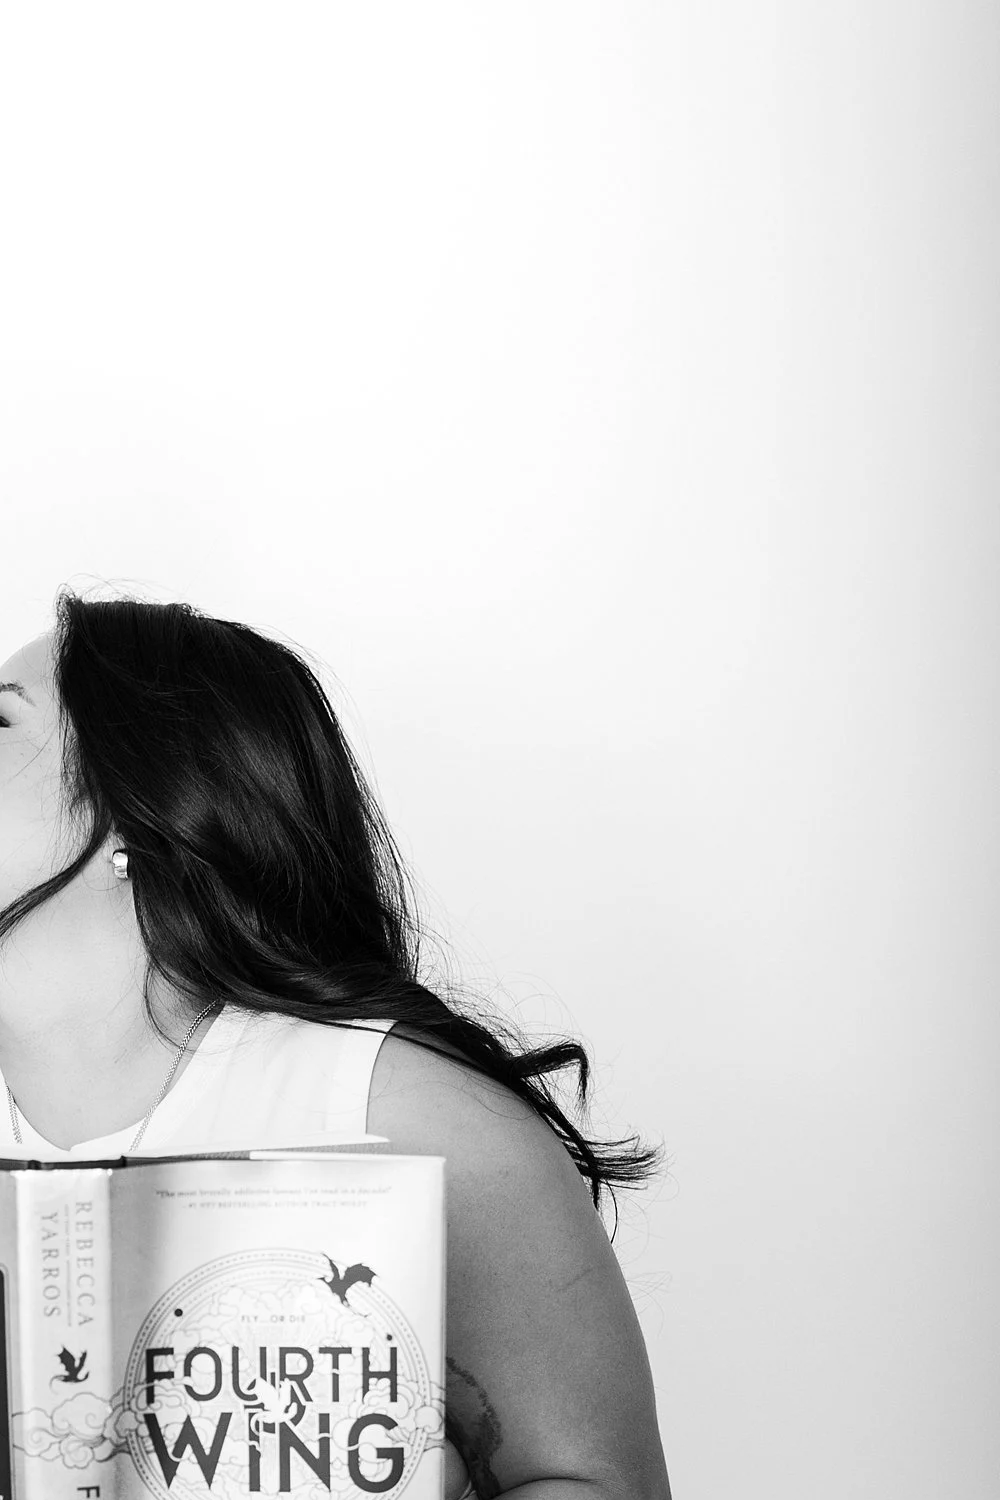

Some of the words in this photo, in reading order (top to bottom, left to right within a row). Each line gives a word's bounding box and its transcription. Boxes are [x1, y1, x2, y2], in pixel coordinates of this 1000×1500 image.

[41, 1211, 61, 1317] YARROS
[75, 1201, 96, 1326] REBECCA
[145, 1345, 398, 1405] FOURTH
[143, 1410, 405, 1494] WING
